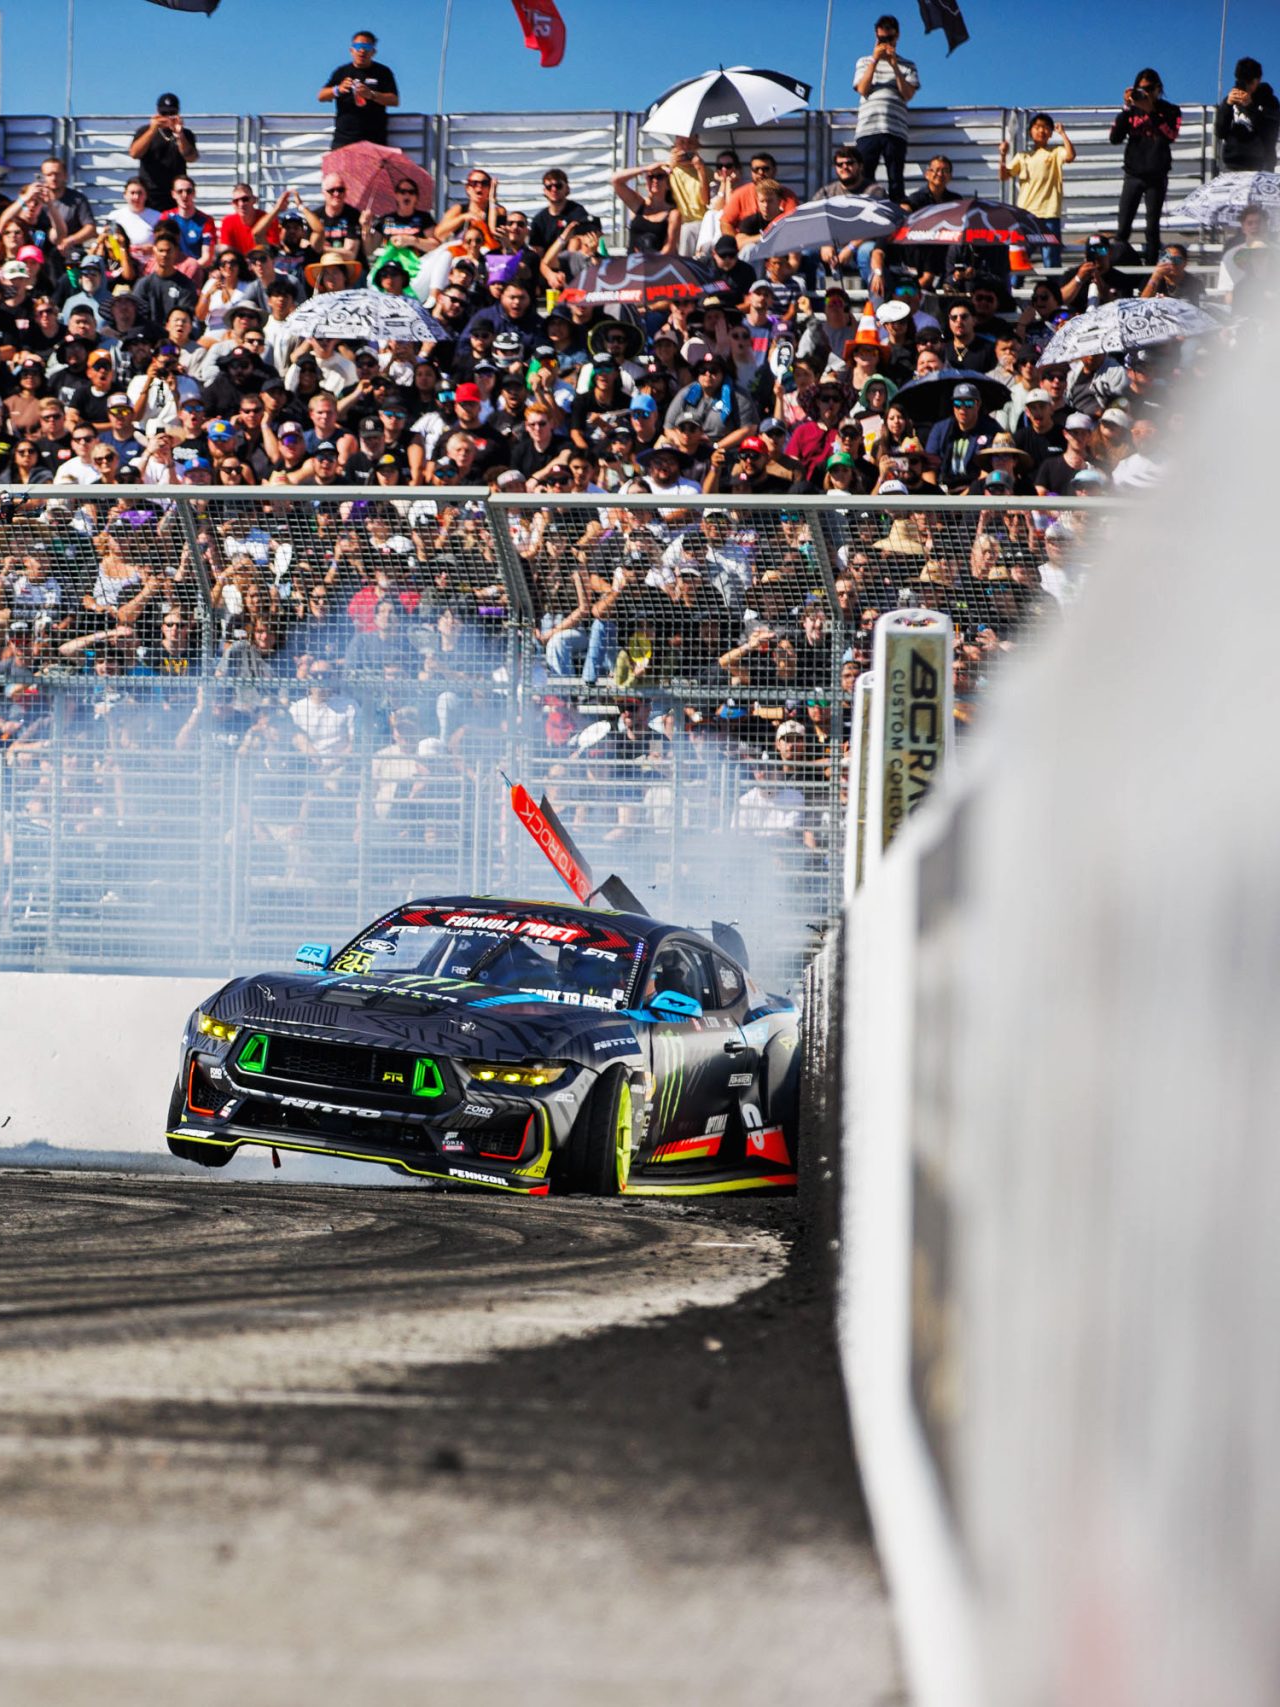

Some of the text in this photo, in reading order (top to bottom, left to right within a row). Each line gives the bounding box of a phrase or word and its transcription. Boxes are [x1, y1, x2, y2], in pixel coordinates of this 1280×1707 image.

[891, 668, 905, 752] CUSTOM
[519, 801, 560, 858] ROCK
[445, 915, 579, 942] FORMULA DRIFT
[280, 1096, 382, 1119] NITTO
[465, 1104, 494, 1115] FORD
[448, 1167, 509, 1187] PENNZOIL
